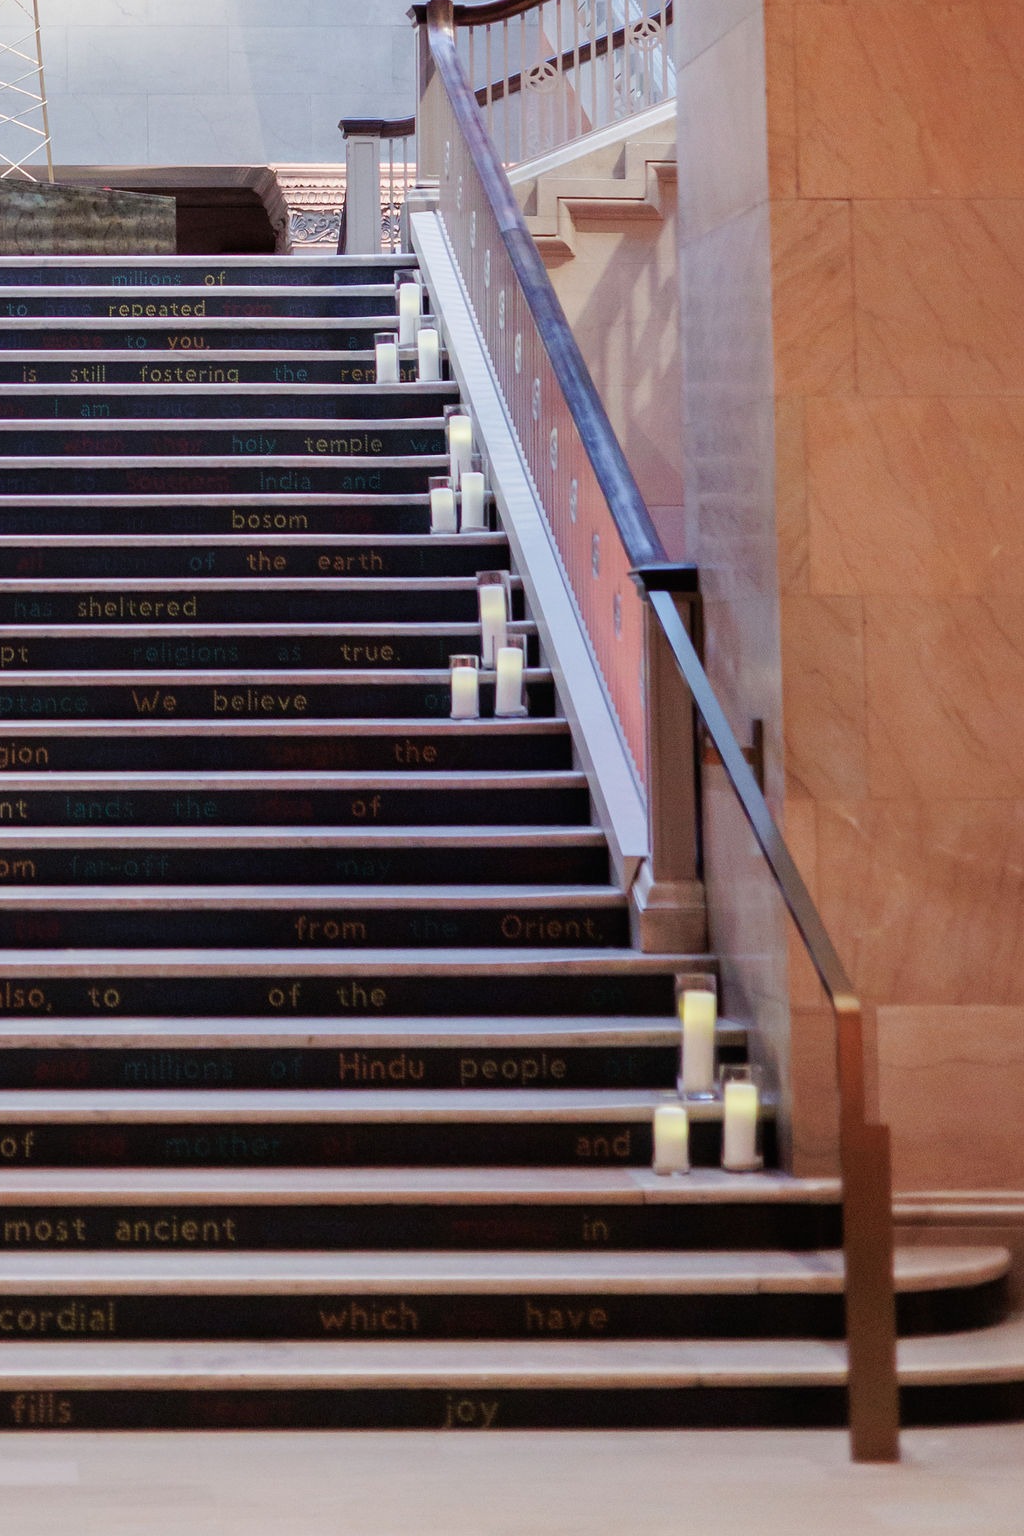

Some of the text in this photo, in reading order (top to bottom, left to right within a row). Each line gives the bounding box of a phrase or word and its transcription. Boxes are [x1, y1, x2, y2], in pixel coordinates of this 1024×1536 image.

[110, 269, 182, 285] millions
[203, 270, 227, 286] of
[5, 302, 28, 318] to
[107, 300, 207, 318] repeated
[123, 332, 147, 349] to
[166, 335, 211, 350] you,
[21, 365, 37, 383] is
[69, 365, 106, 383] still
[138, 365, 240, 384] fostering
[272, 365, 308, 383] the
[231, 433, 277, 455] holy
[304, 433, 384, 455] temple
[230, 509, 309, 529] bosom
[245, 550, 288, 571] the
[317, 550, 384, 571] earth
[77, 595, 198, 618] sheltered
[339, 642, 403, 663] true.
[131, 690, 179, 712] We
[212, 690, 309, 712] believe
[392, 741, 438, 764] the
[350, 797, 383, 818] of
[294, 914, 369, 939] from
[87, 984, 122, 1007] to
[267, 983, 303, 1007] of
[336, 982, 387, 1007] the
[337, 1053, 426, 1079] Hindu
[458, 1053, 568, 1084] people
[575, 1130, 632, 1157] and
[2, 1214, 87, 1240] most
[114, 1212, 237, 1240] ancient
[582, 1213, 610, 1241] in
[319, 1302, 419, 1332] which
[525, 1301, 609, 1331] have
[9, 1394, 72, 1423] fills
[443, 1393, 499, 1426] joy
